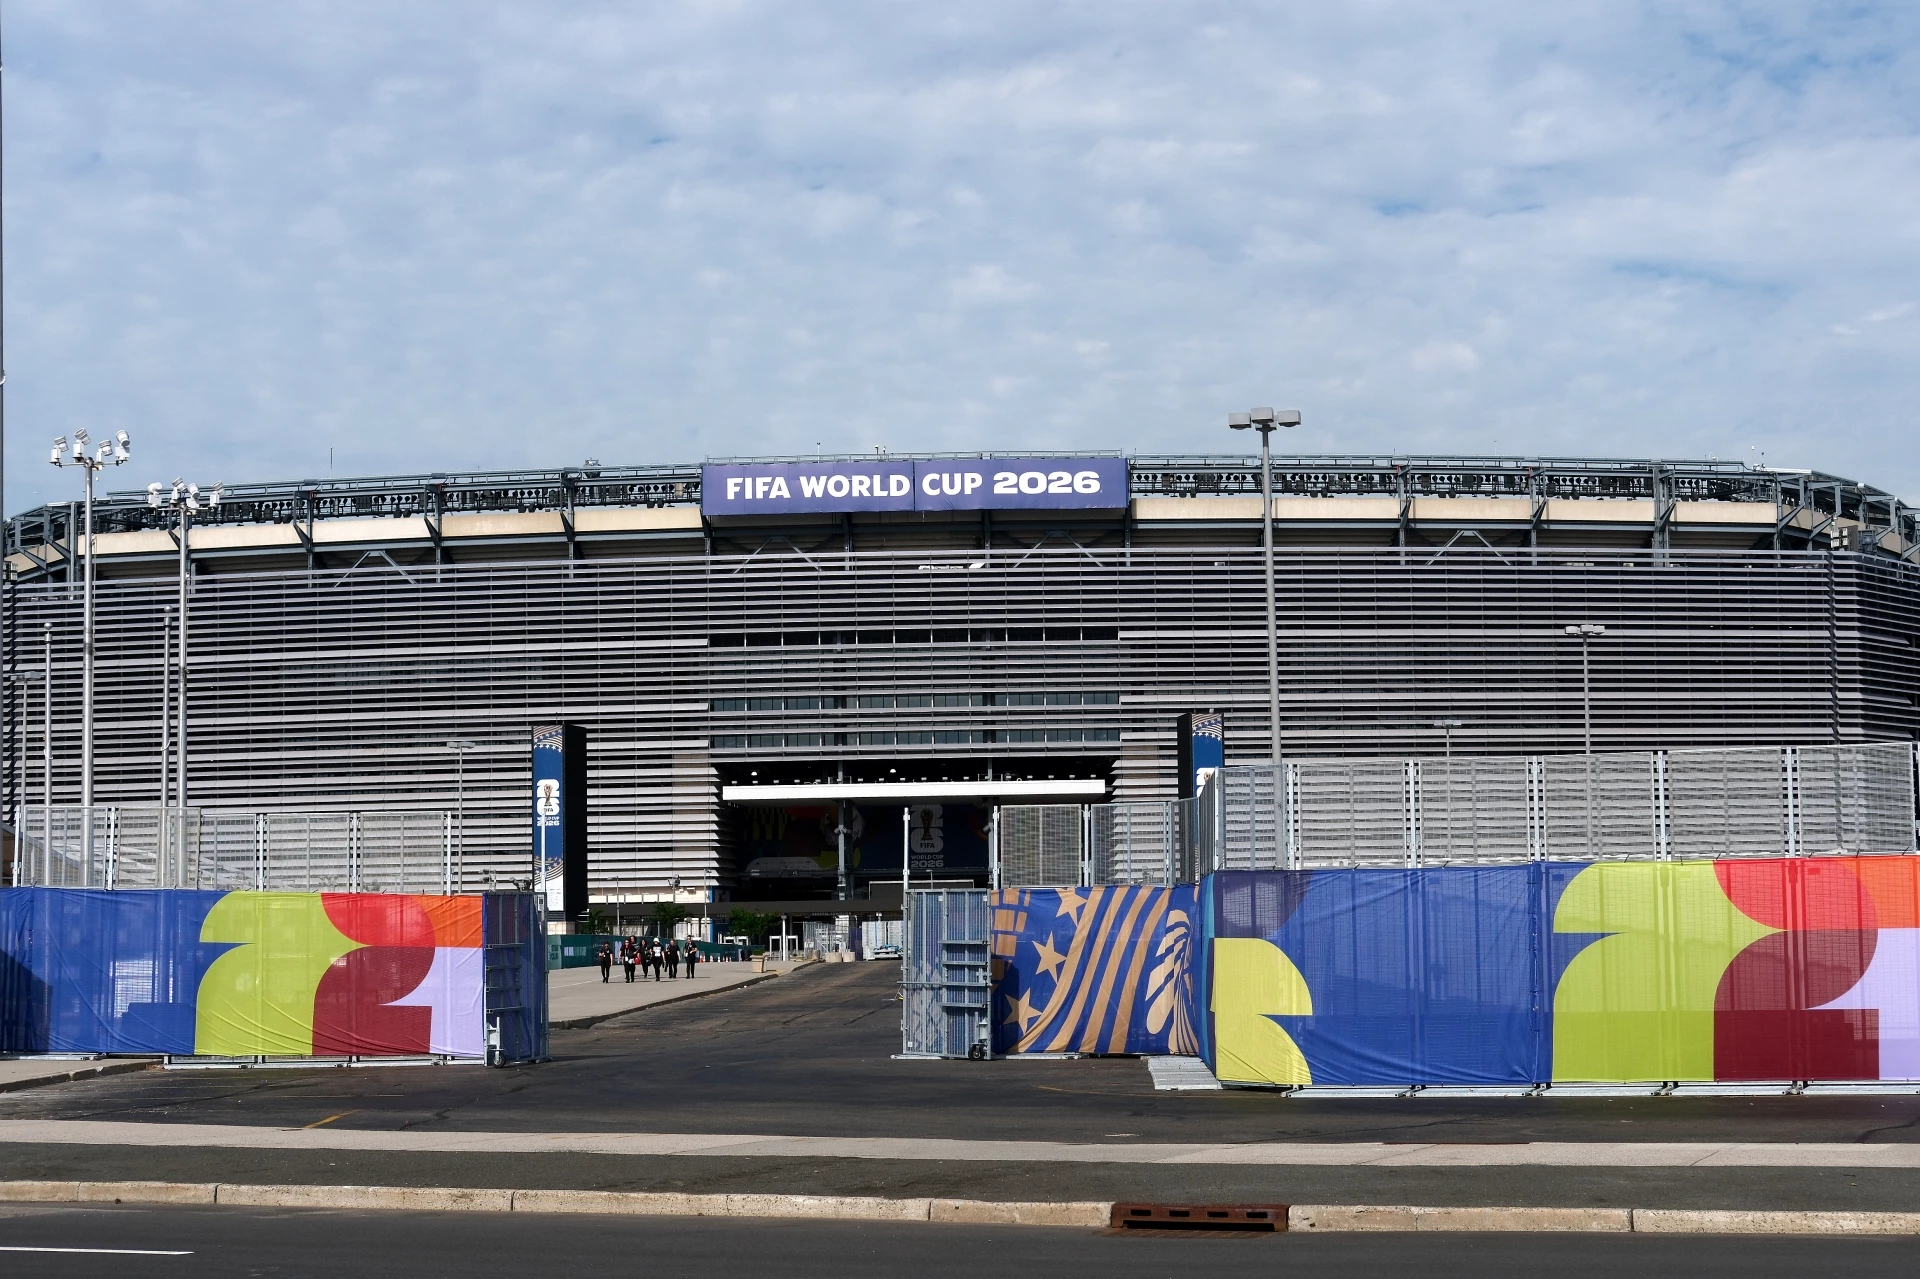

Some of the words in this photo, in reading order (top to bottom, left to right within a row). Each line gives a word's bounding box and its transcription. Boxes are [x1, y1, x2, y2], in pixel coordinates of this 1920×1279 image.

[726, 476, 792, 500] FIFA
[798, 474, 911, 499] WORLD
[921, 472, 983, 496] CUP
[993, 470, 1101, 495] 2026
